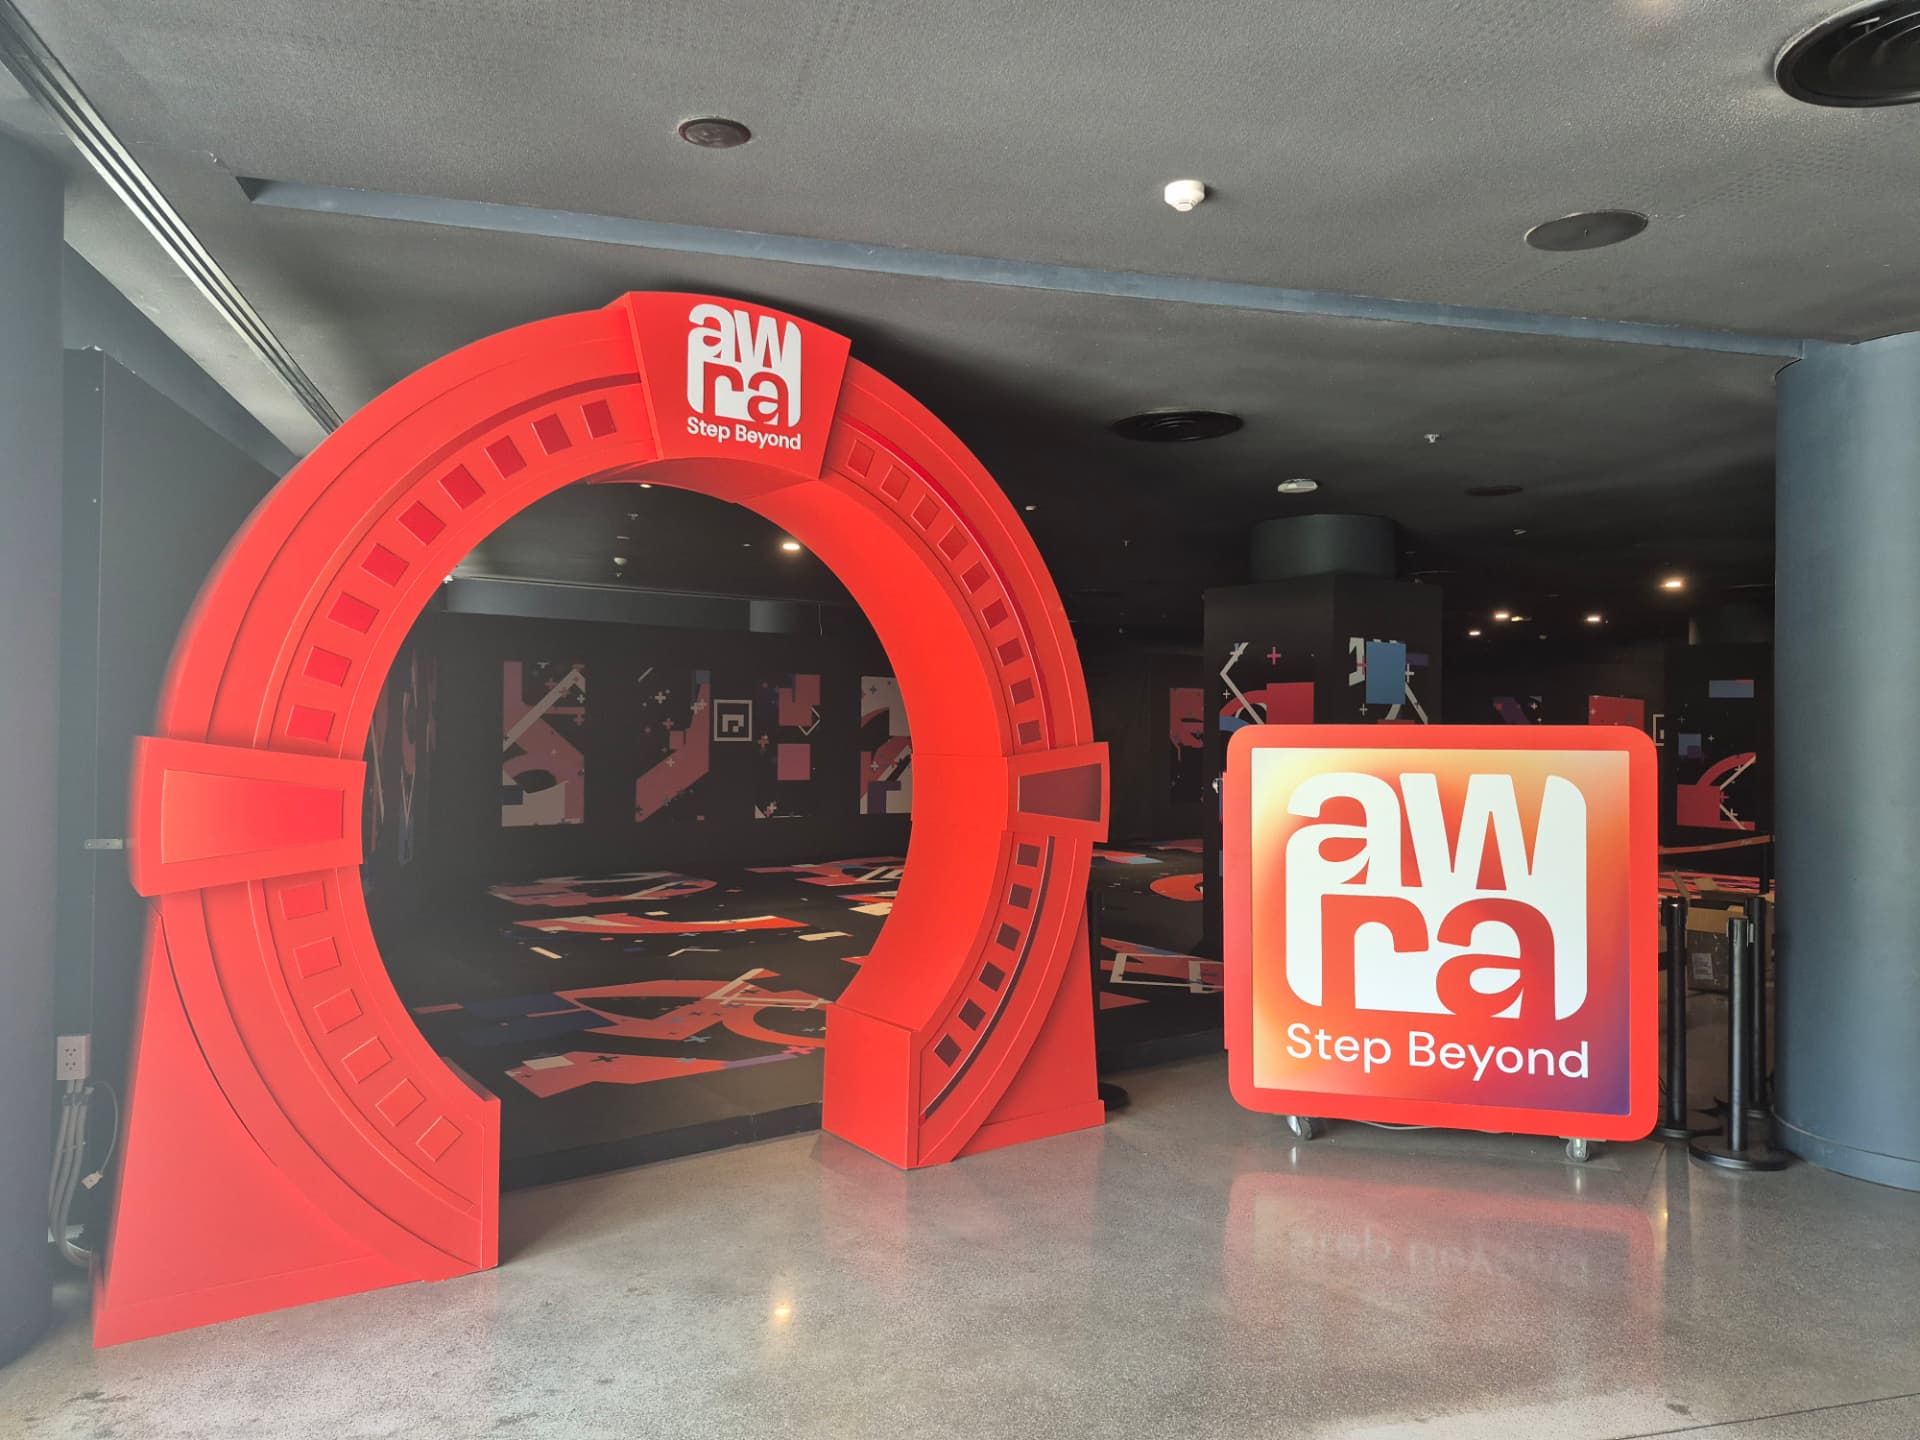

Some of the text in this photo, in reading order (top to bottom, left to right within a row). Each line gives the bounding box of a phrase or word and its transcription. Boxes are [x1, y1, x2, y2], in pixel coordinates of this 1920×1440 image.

[687, 416, 802, 450] Step Beyond
[1286, 1022, 1590, 1082] Step Beyond
